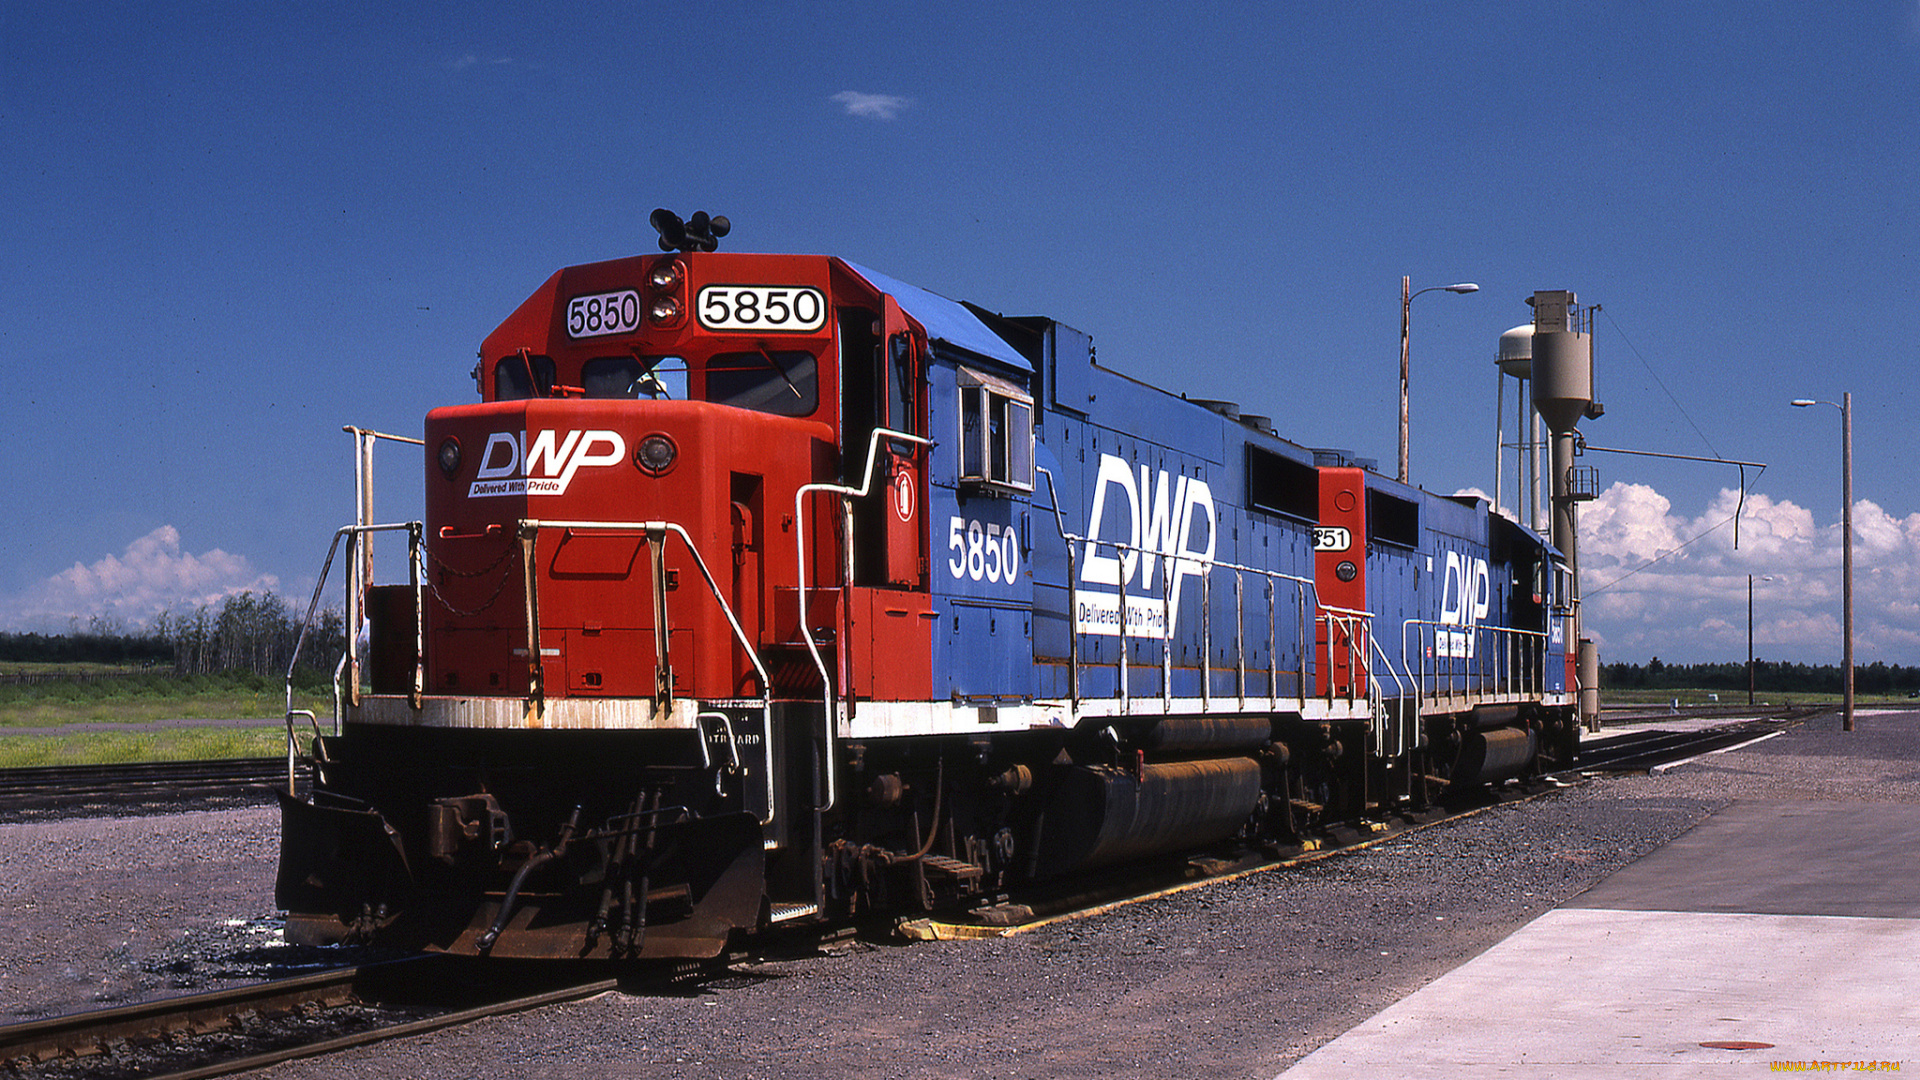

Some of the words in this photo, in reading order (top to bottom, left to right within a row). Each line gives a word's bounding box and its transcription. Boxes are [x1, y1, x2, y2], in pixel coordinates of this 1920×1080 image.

[569, 293, 638, 335] 5850
[703, 290, 820, 325] 5850
[476, 429, 626, 480] DWP
[473, 480, 507, 495] Delivered
[508, 481, 526, 493] With
[527, 480, 560, 492] Pride
[1079, 452, 1216, 592] DWP
[948, 515, 1019, 586] 5850
[1439, 549, 1490, 630] DWP
[1146, 607, 1166, 628] Prid
